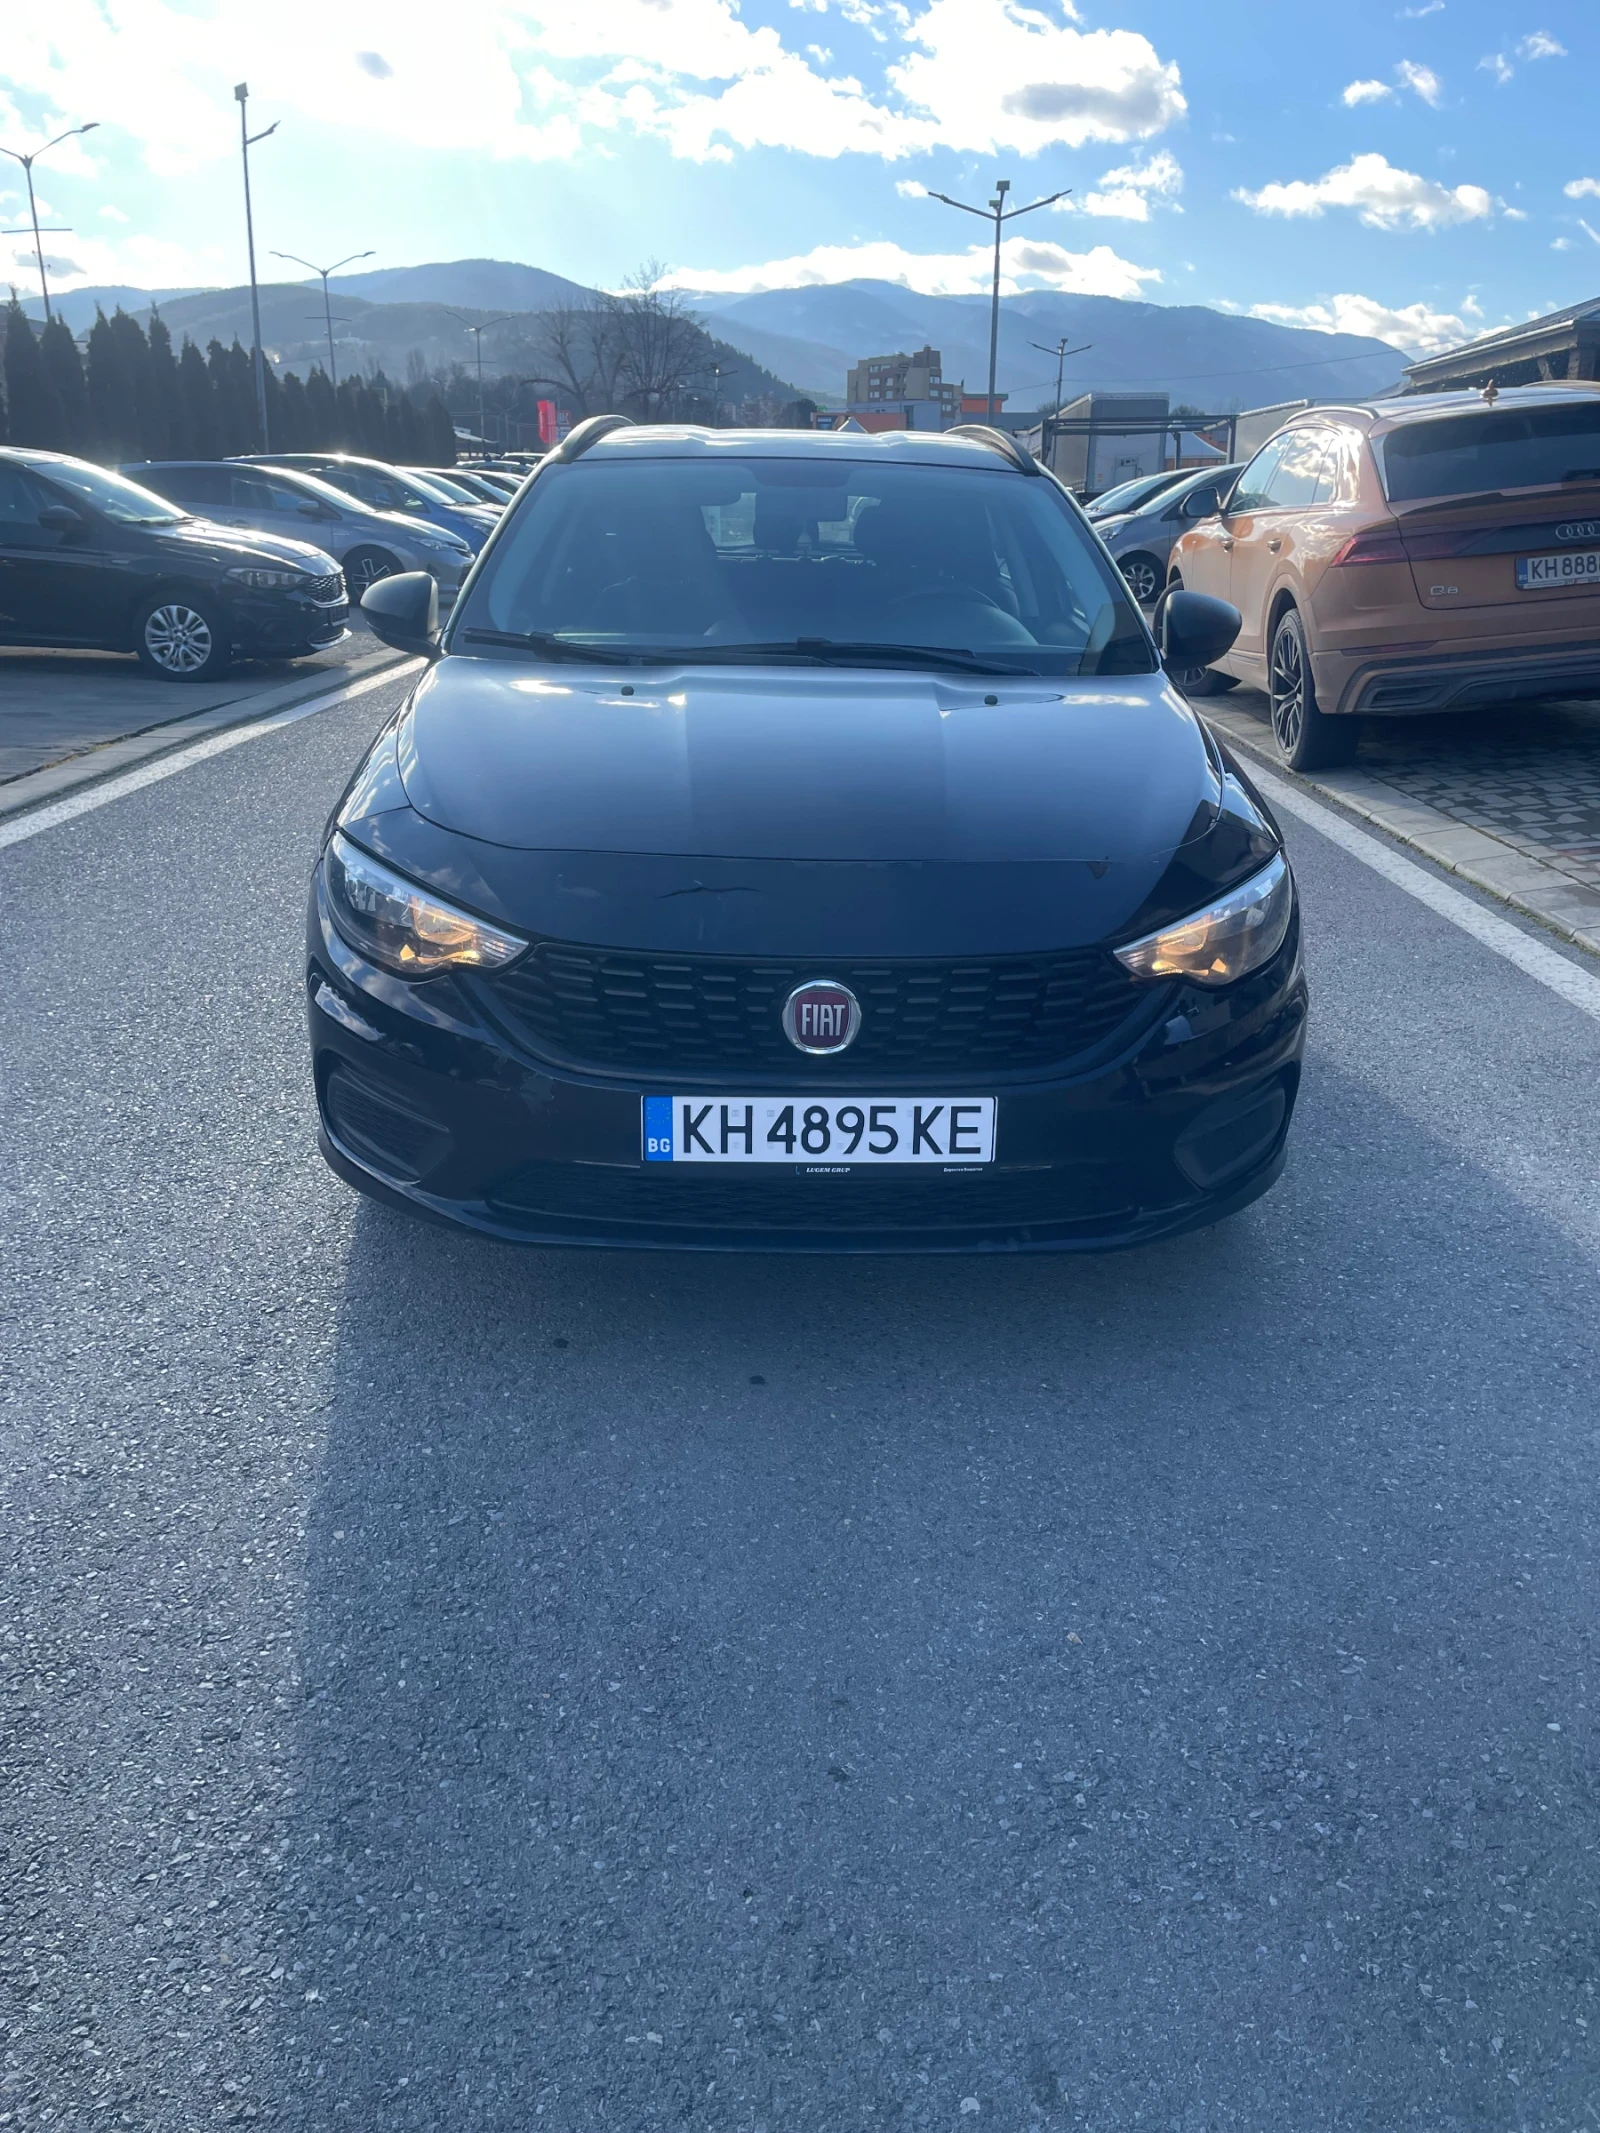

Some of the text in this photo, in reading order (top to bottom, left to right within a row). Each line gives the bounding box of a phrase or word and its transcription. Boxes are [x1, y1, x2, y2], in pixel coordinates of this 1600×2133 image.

[1531, 554, 1600, 580] KH 888
[1430, 585, 1459, 596] Q8
[801, 1003, 846, 1036] FIAT
[683, 1104, 982, 1155] KH 4895 KE
[647, 1137, 671, 1153] BG
